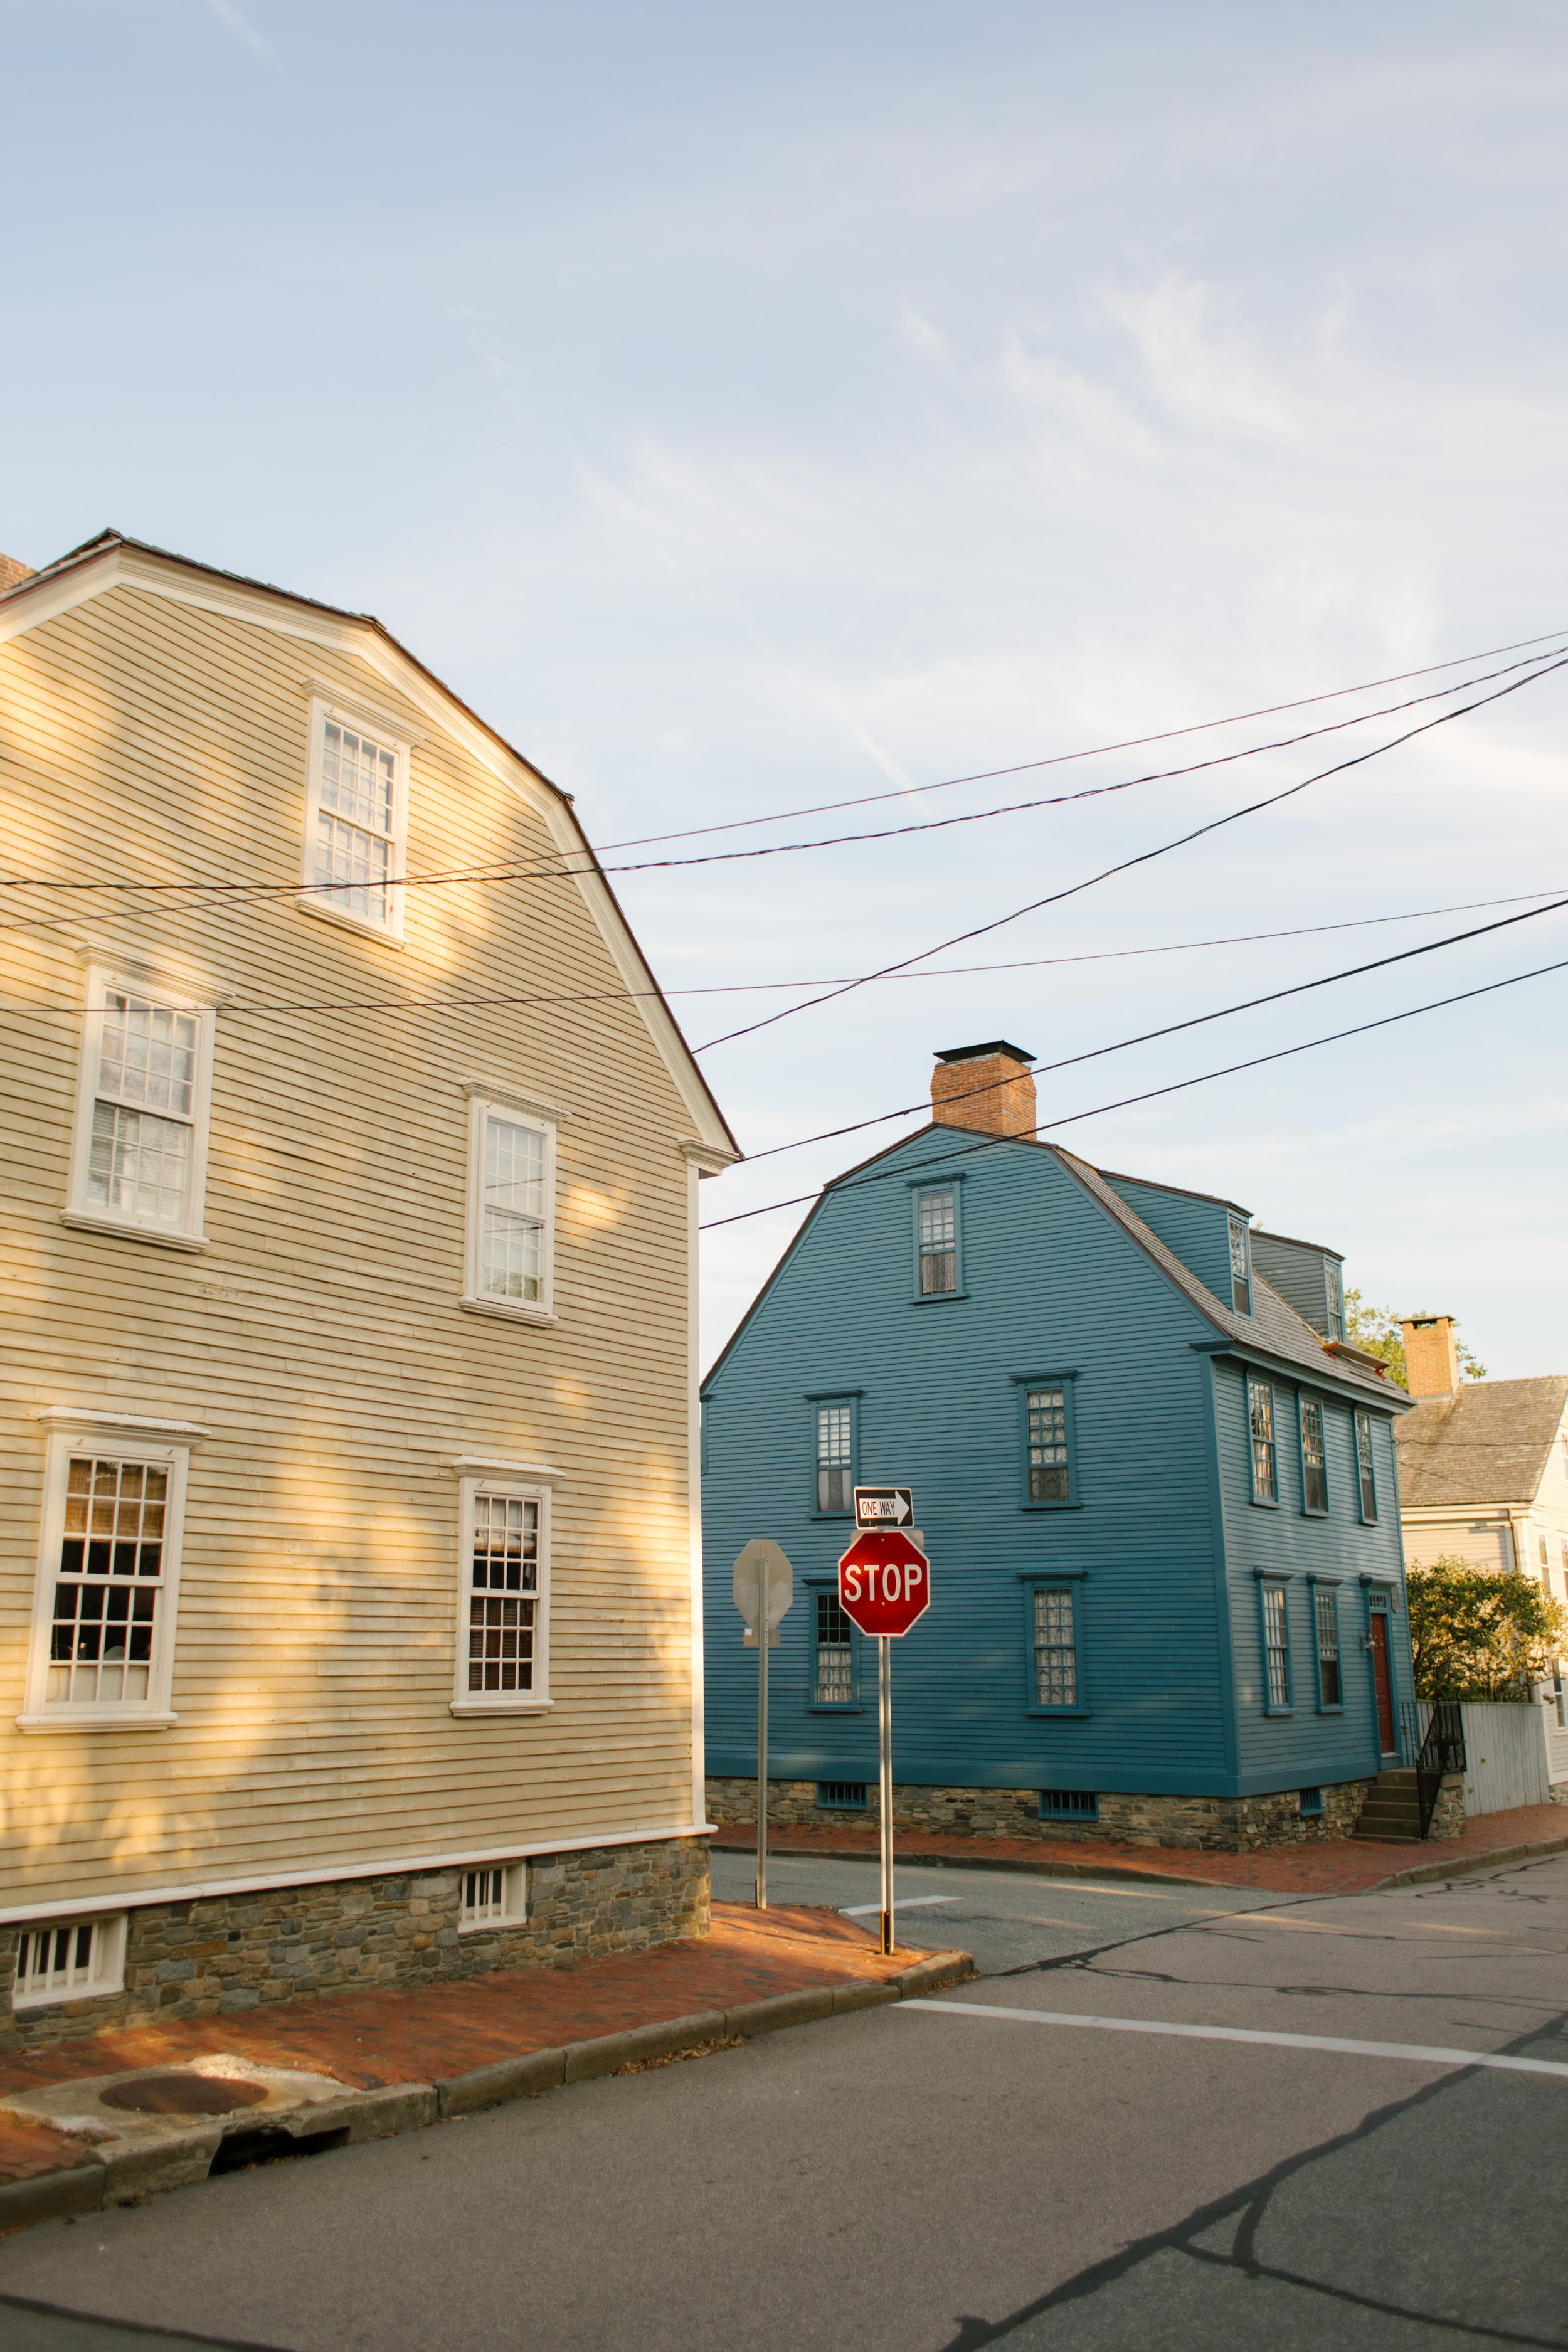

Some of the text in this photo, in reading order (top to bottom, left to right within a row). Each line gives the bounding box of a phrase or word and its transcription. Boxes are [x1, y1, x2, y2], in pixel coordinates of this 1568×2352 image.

[862, 1501, 895, 1515] ONE WAY
[844, 1564, 923, 1602] STOP
